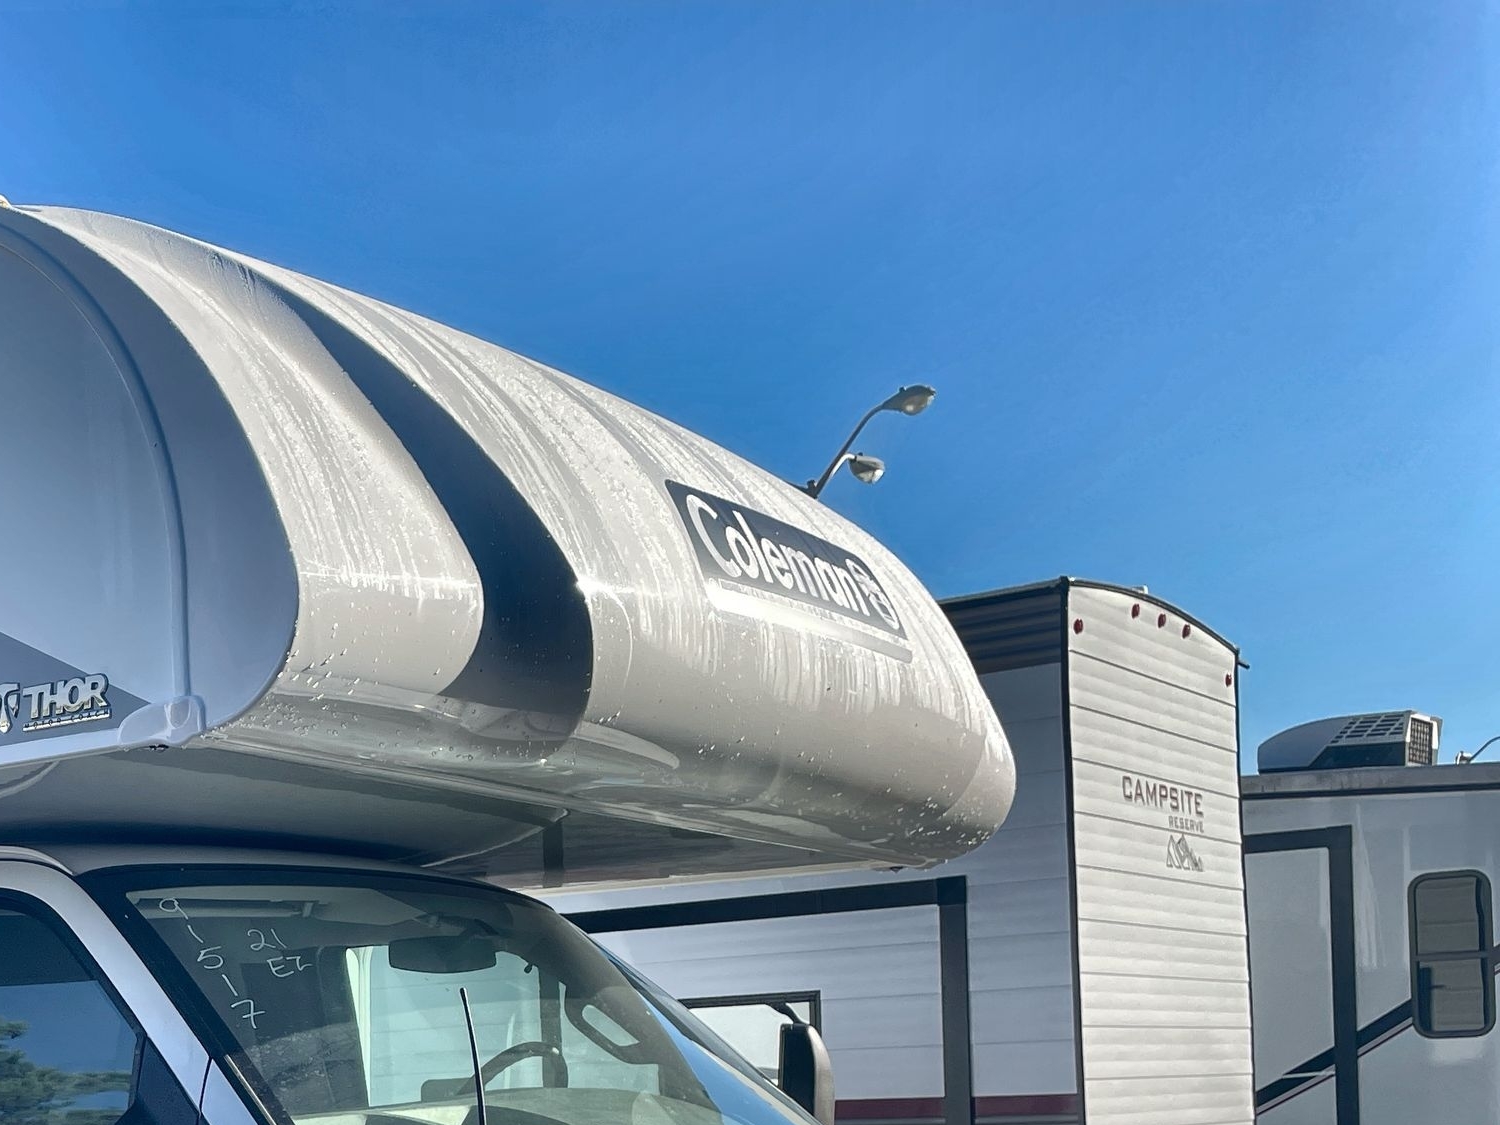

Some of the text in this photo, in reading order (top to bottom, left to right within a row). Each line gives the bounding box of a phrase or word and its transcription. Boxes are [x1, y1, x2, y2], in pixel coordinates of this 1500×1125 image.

[686, 494, 870, 617] Coleman
[22, 673, 110, 719] THOR
[1122, 775, 1204, 817] CAMPSITE
[1168, 815, 1204, 833] RESERVE
